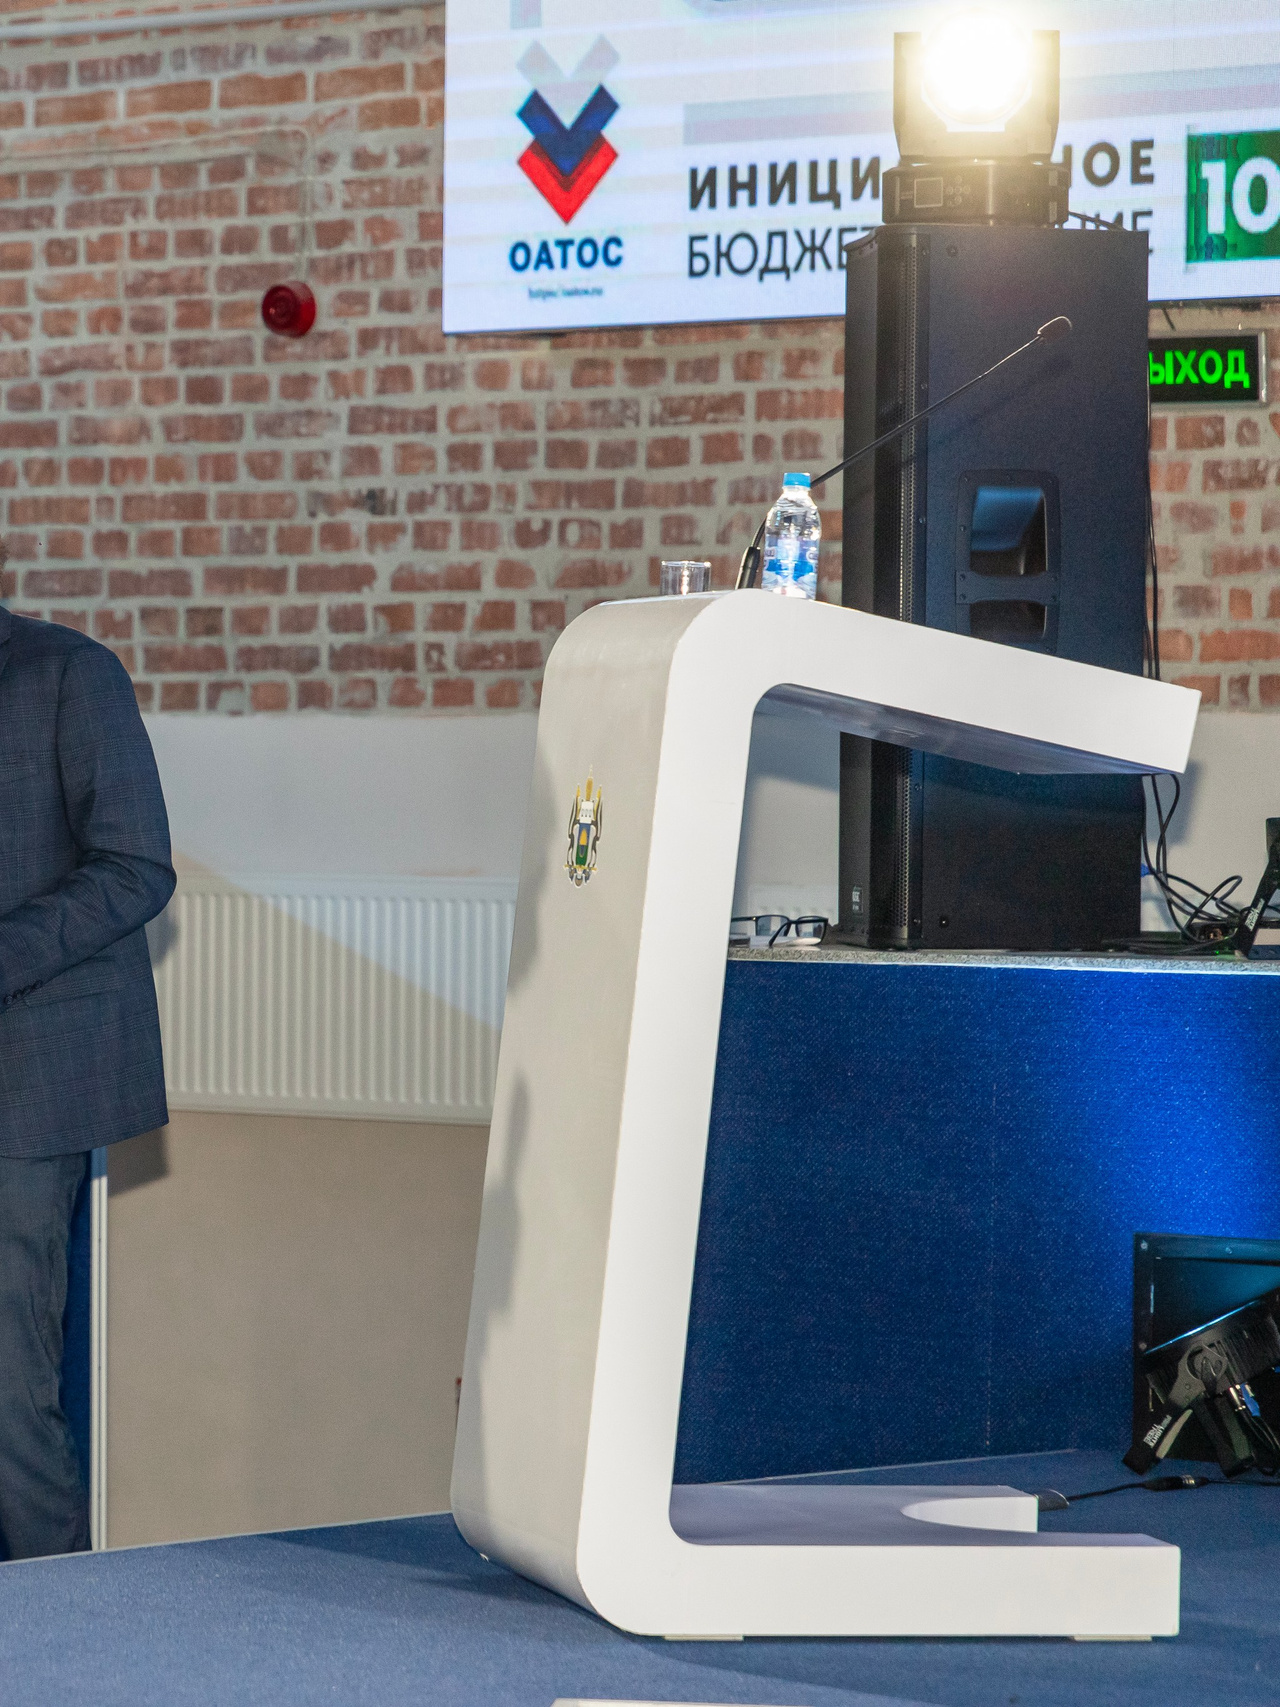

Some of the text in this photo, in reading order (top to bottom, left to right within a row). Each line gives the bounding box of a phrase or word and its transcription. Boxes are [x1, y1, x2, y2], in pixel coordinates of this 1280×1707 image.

[1201, 156, 1280, 235] 10
[508, 236, 623, 272] ОАТОС
[1148, 348, 1251, 389] ЫХОД
